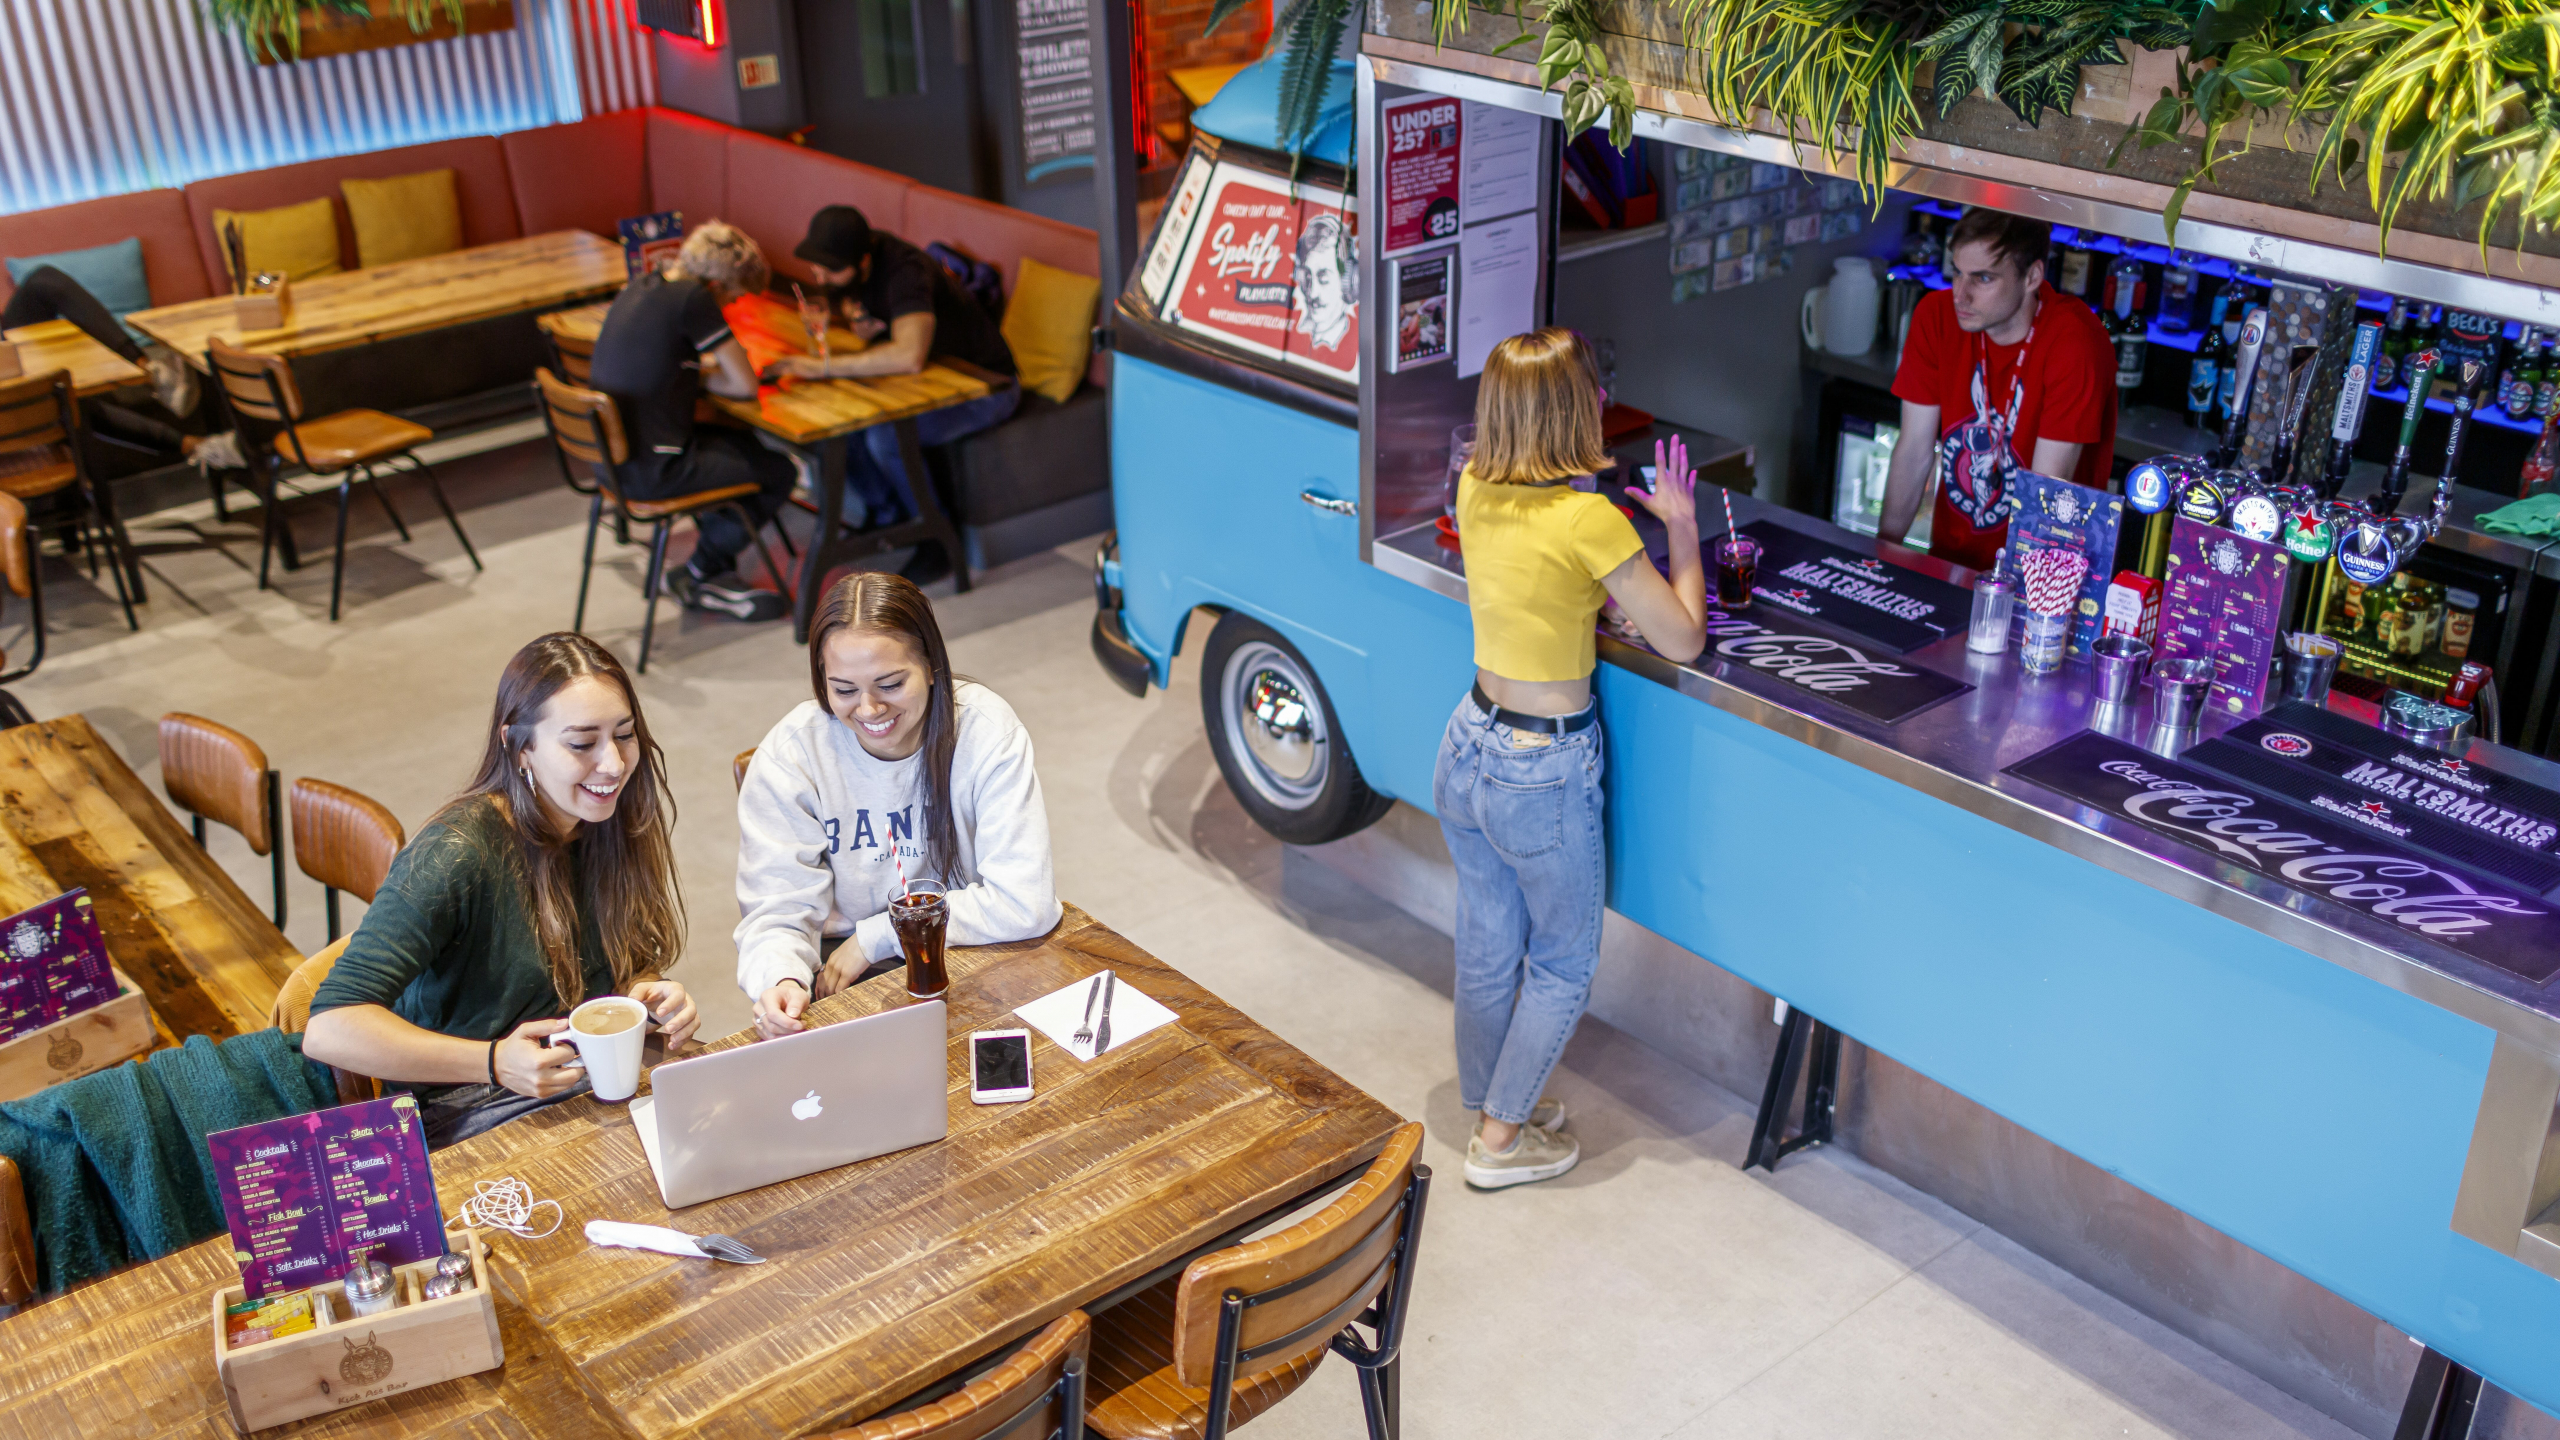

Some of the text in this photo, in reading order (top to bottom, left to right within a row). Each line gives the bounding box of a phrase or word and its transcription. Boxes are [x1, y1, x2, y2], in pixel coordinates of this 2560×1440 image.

[1392, 104, 1456, 133] UNDER
[1393, 131, 1425, 152] 25?
[1223, 203, 1248, 217] CHECK
[1248, 205, 1266, 218] OUT
[1432, 210, 1457, 236] 25
[1208, 222, 1283, 280] Spotify
[1239, 286, 1288, 302] PLAYLISTS
[2448, 312, 2499, 335] BECK'S
[2359, 329, 2373, 363] LAGER
[2339, 381, 2357, 429] MALTSMITHS
[2405, 376, 2422, 421] Heineken
[2446, 418, 2462, 455] GUINNESS
[1943, 437, 1962, 485] KICK
[2183, 502, 2217, 516] STRONGBOW
[2236, 500, 2275, 525] MALTSMITHS
[2343, 553, 2386, 571] GUINNESS
[1783, 561, 1936, 617] MALTSMITHS
[2099, 761, 2208, 805] Coca-Cola
[2391, 754, 2486, 793] Heineken
[2342, 772, 2542, 849] BREWING COLLABORATION
[2351, 761, 2558, 843] MALTSMITHS
[2311, 795, 2406, 837] Heineken
[880, 846, 919, 862] CAADA
[2123, 790, 2549, 937] Coca-Cola
[351, 1127, 374, 1138] Shots
[254, 1144, 289, 1158] Cocktails
[352, 1157, 386, 1169] Shooters
[363, 1193, 389, 1204] Bombs
[268, 1206, 306, 1223] Fish Bowl
[363, 1223, 401, 1239] Hot Drinks
[276, 1256, 319, 1272] Soft Drinks
[338, 1381, 408, 1404] Kick Ass Bar
